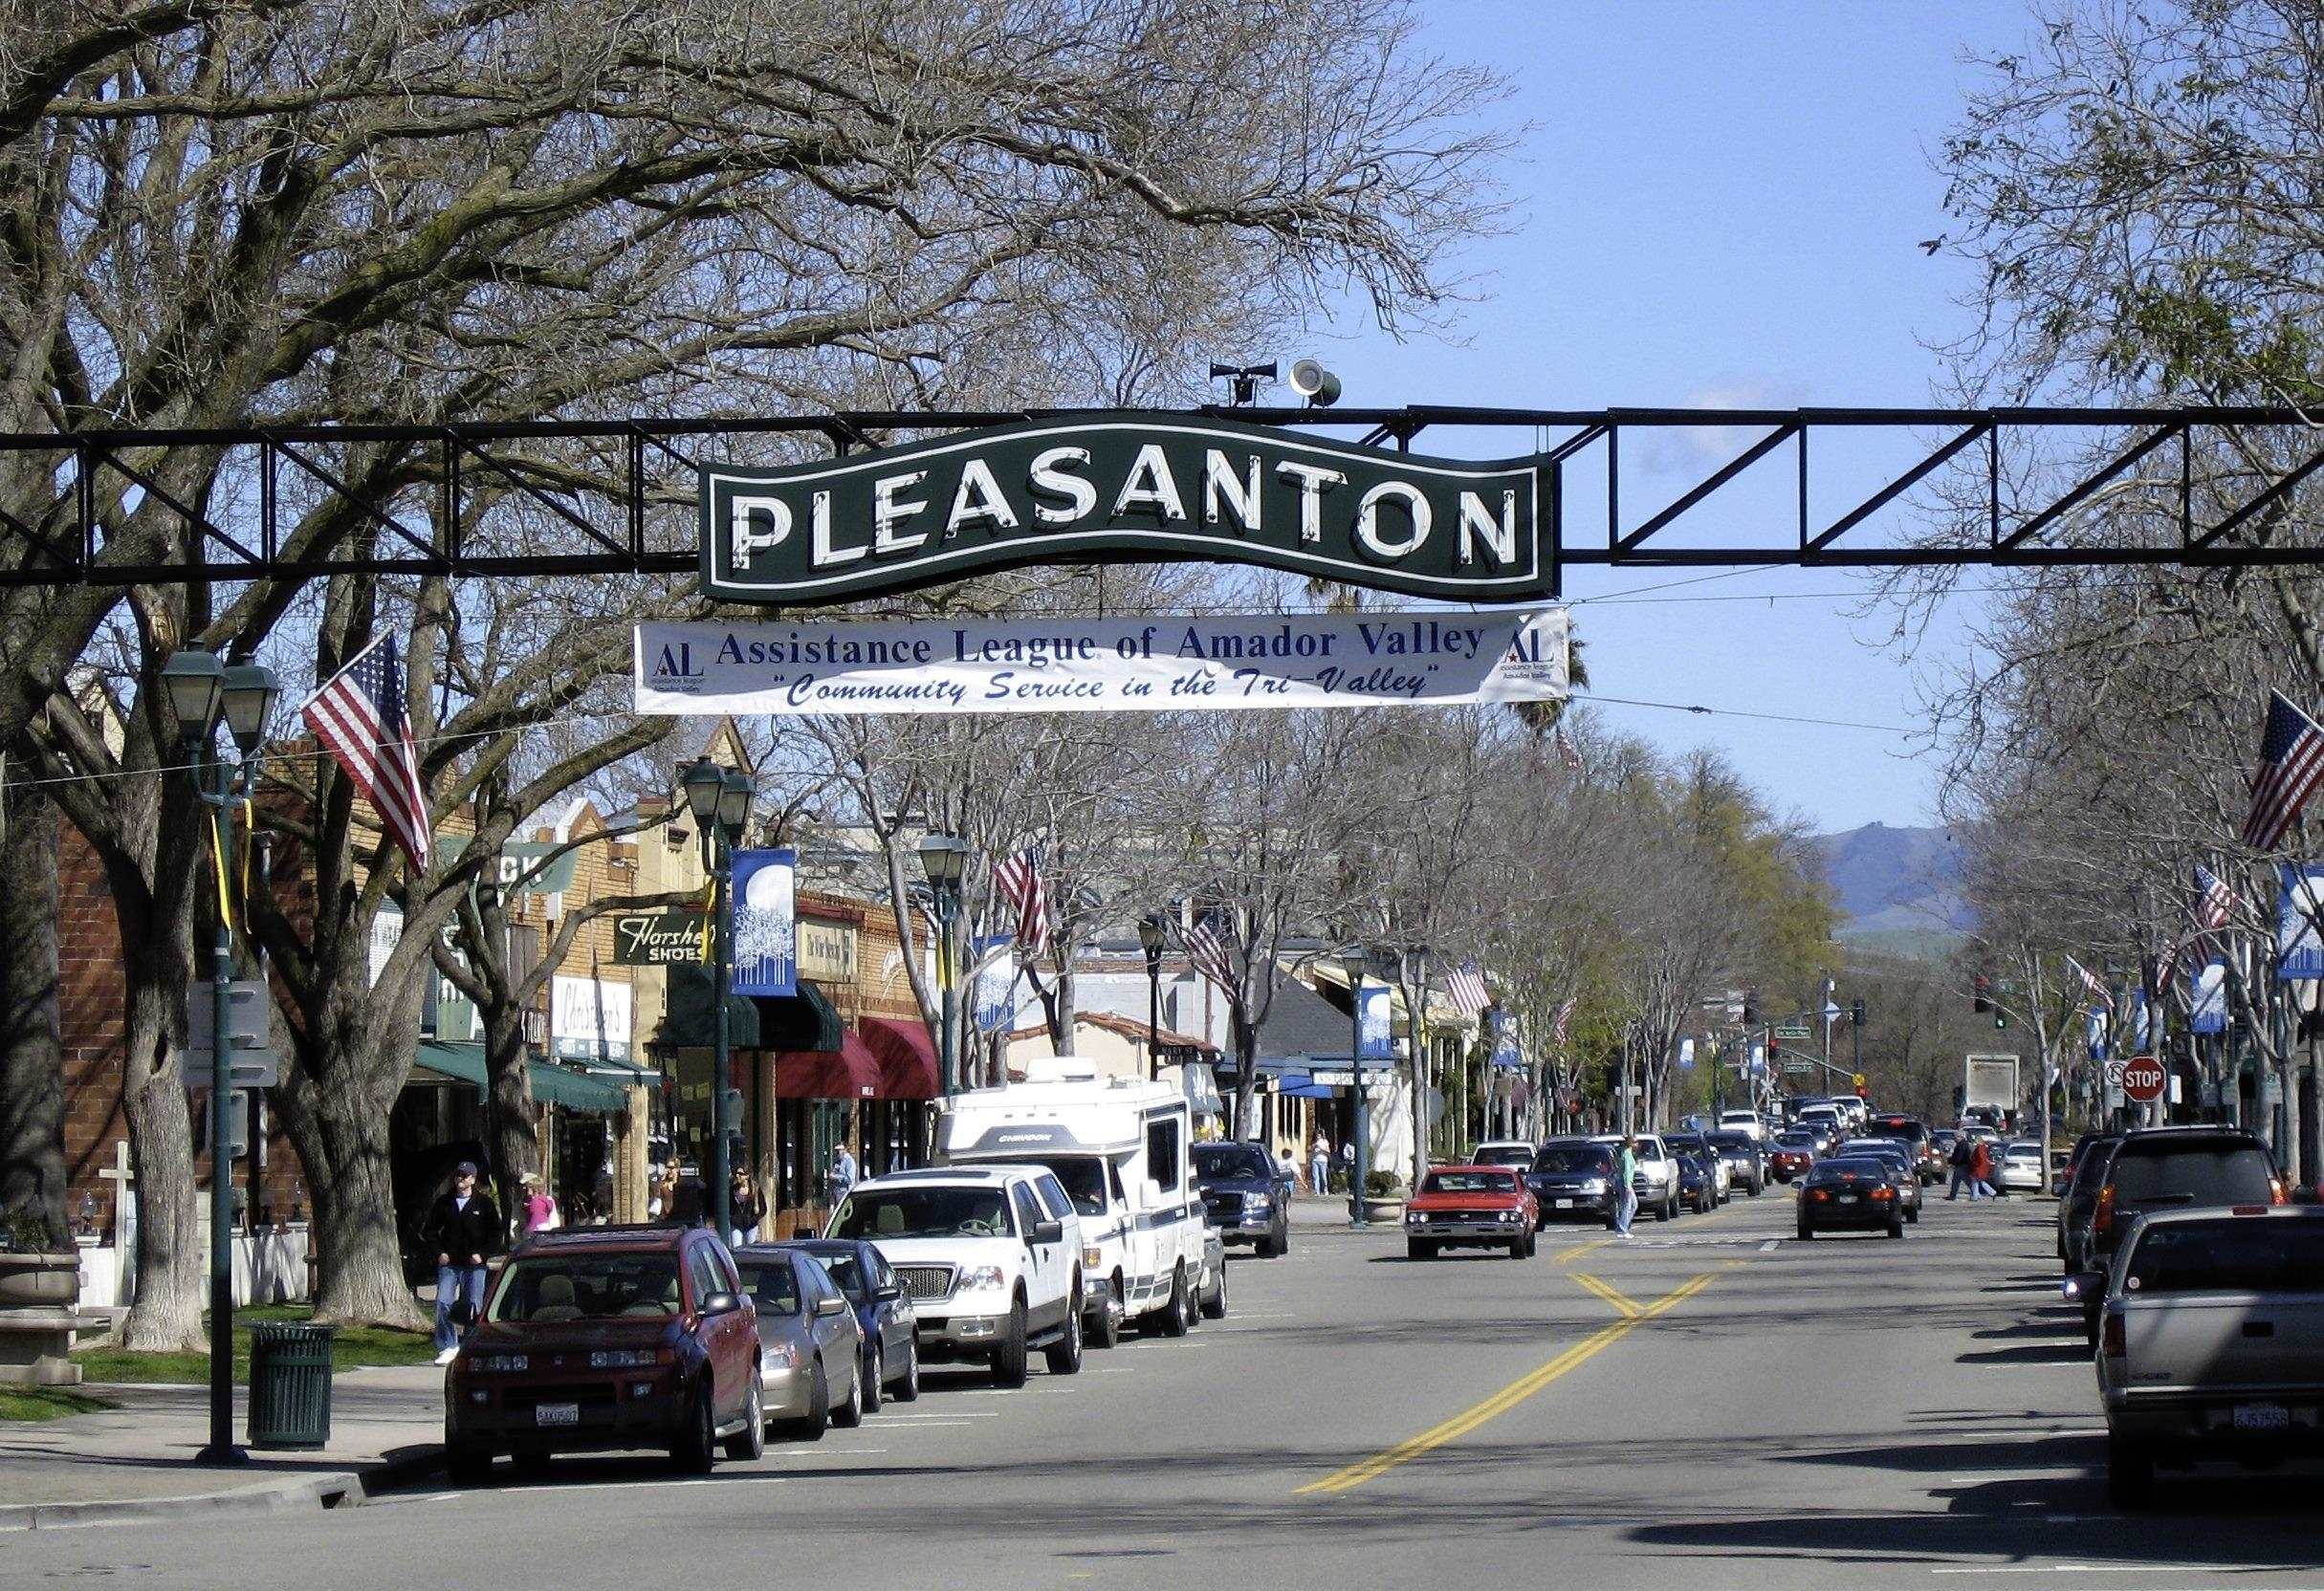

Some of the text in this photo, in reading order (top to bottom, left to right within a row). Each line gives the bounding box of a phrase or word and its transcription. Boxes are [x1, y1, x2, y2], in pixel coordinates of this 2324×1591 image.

[732, 444, 1516, 570] PLEASANTON
[652, 643, 704, 676] AL
[715, 621, 1485, 668] Assistance League of Amador Valley
[1503, 628, 1554, 662] AL
[983, 671, 1105, 700] Service
[1122, 675, 1152, 696] in
[1170, 667, 1217, 696] the
[2125, 1071, 2161, 1088] STOP
[998, 1133, 1053, 1144] CHINOOK
